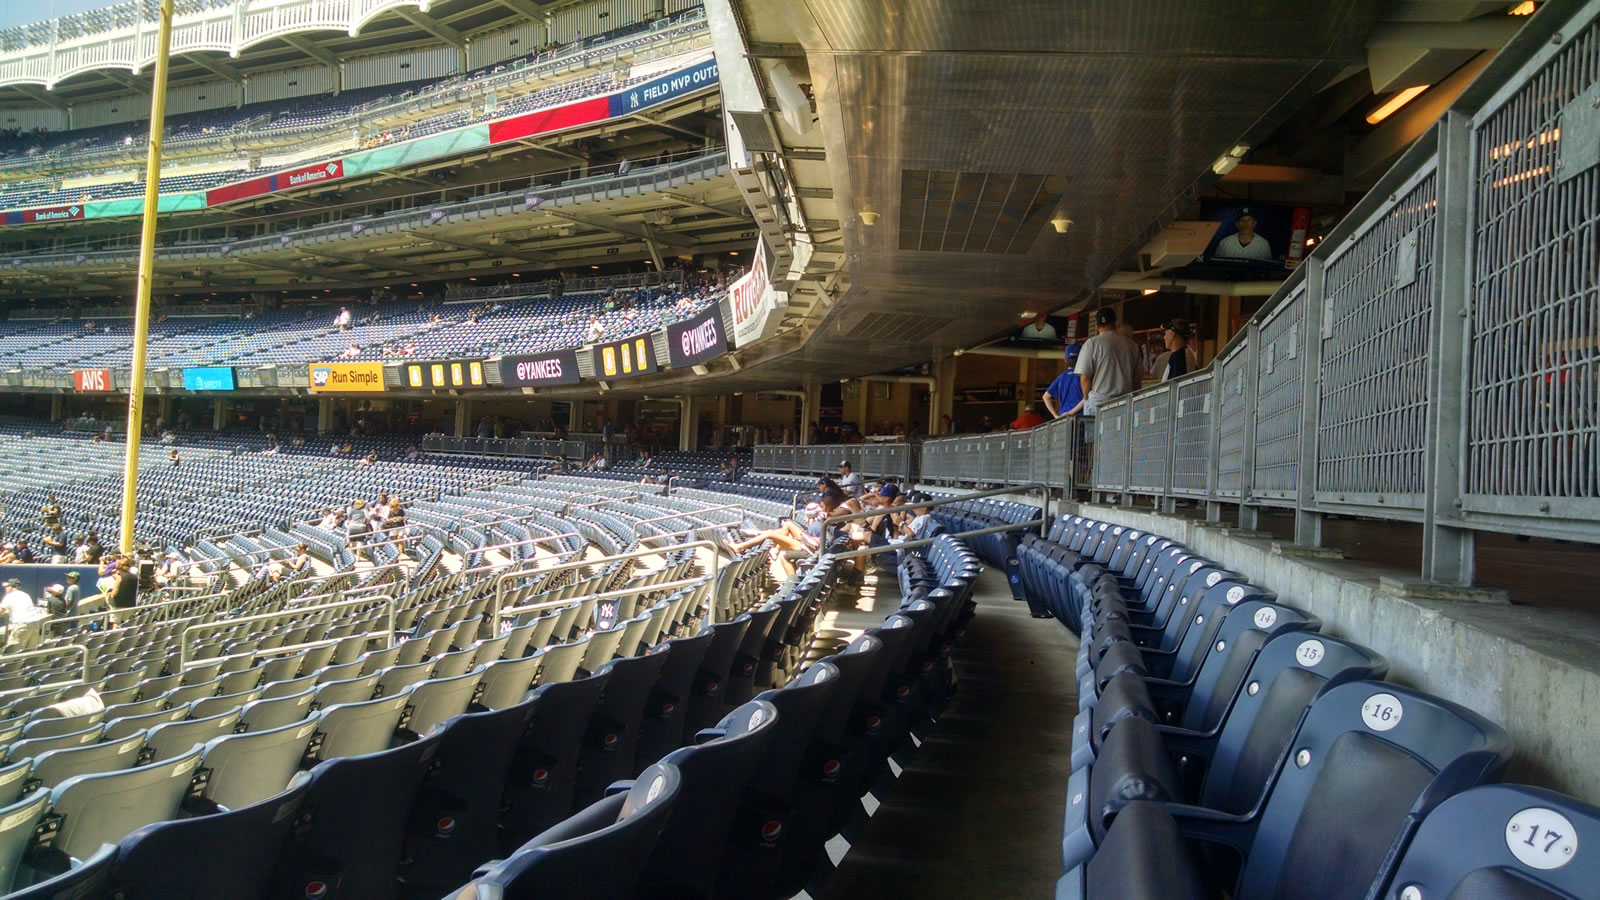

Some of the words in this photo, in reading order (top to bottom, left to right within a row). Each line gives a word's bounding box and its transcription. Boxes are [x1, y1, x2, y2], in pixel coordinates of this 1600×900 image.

[644, 83, 668, 101] FIELD
[671, 75, 690, 92] MVP
[289, 174, 302, 184] Bank
[307, 169, 326, 180] America
[35, 212, 47, 220] Bank
[681, 317, 717, 356] @YANKEES
[313, 371, 329, 383] SAP
[332, 371, 348, 383] Run
[350, 369, 378, 387] Simple
[516, 358, 562, 380] @YANKEES
[81, 370, 104, 390] AVIS
[1231, 591, 1240, 599] 13
[1260, 613, 1271, 623] 14
[1302, 646, 1317, 660] 15
[1371, 703, 1393, 721] 16
[1523, 824, 1563, 854] 17
